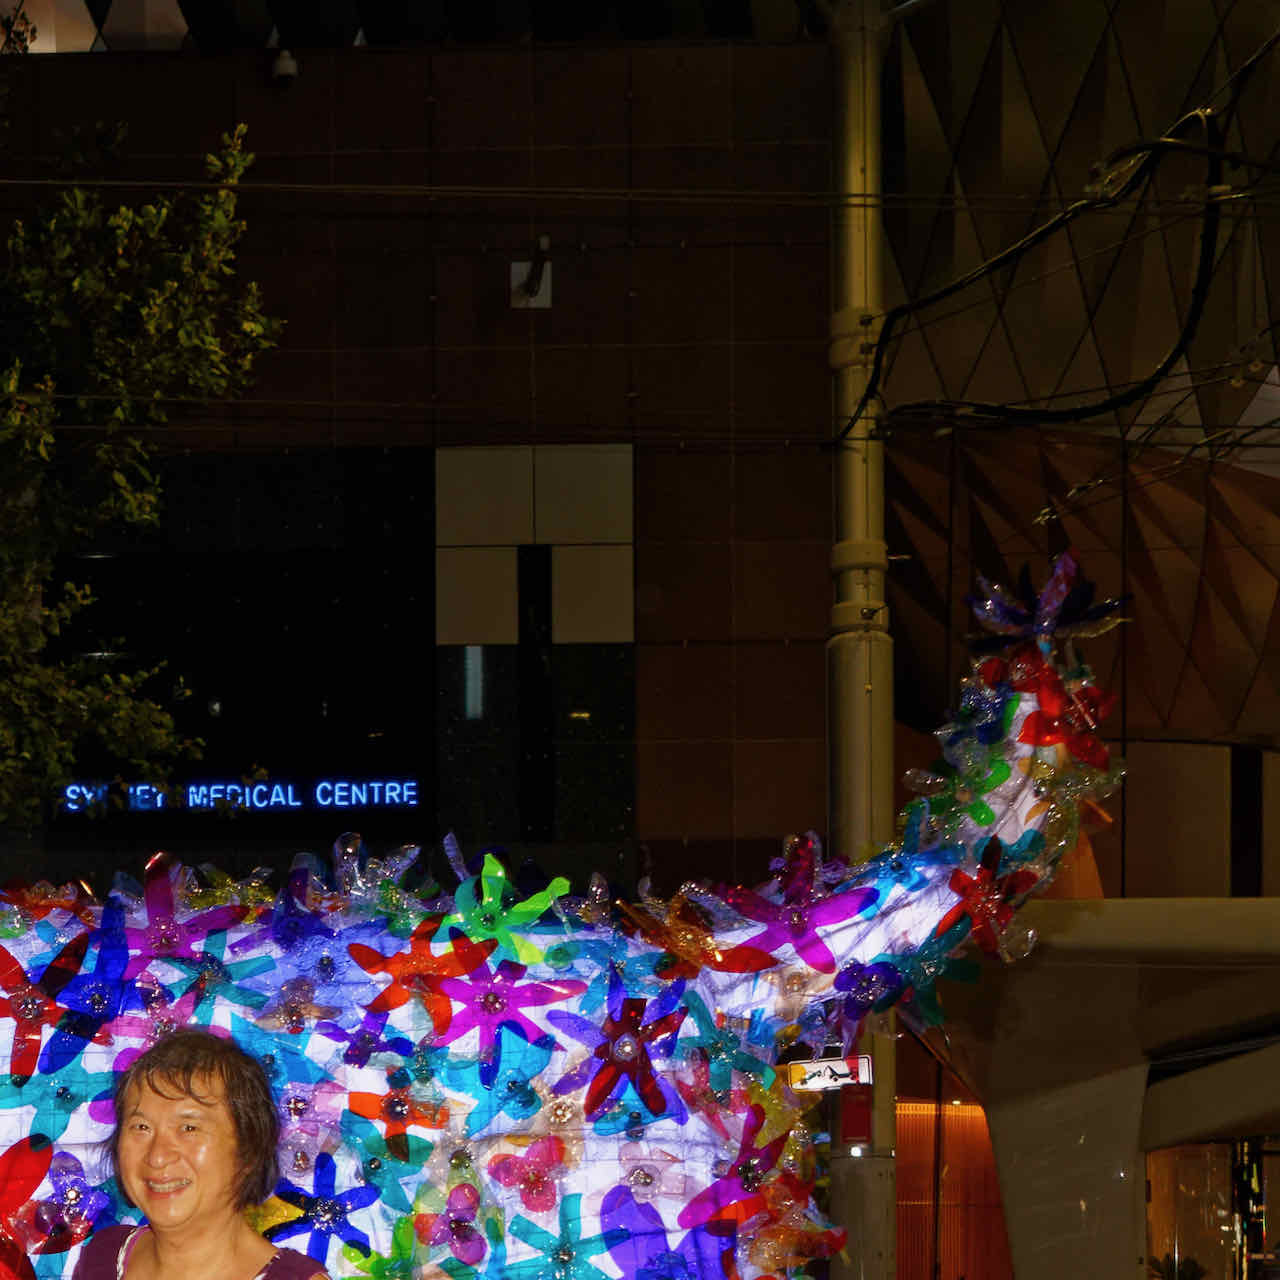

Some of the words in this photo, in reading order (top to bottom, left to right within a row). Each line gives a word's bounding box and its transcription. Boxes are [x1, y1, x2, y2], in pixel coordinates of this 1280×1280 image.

[66, 784, 163, 809] SYEY
[188, 783, 304, 808] MEDICAL
[315, 780, 419, 807] CENTRE
